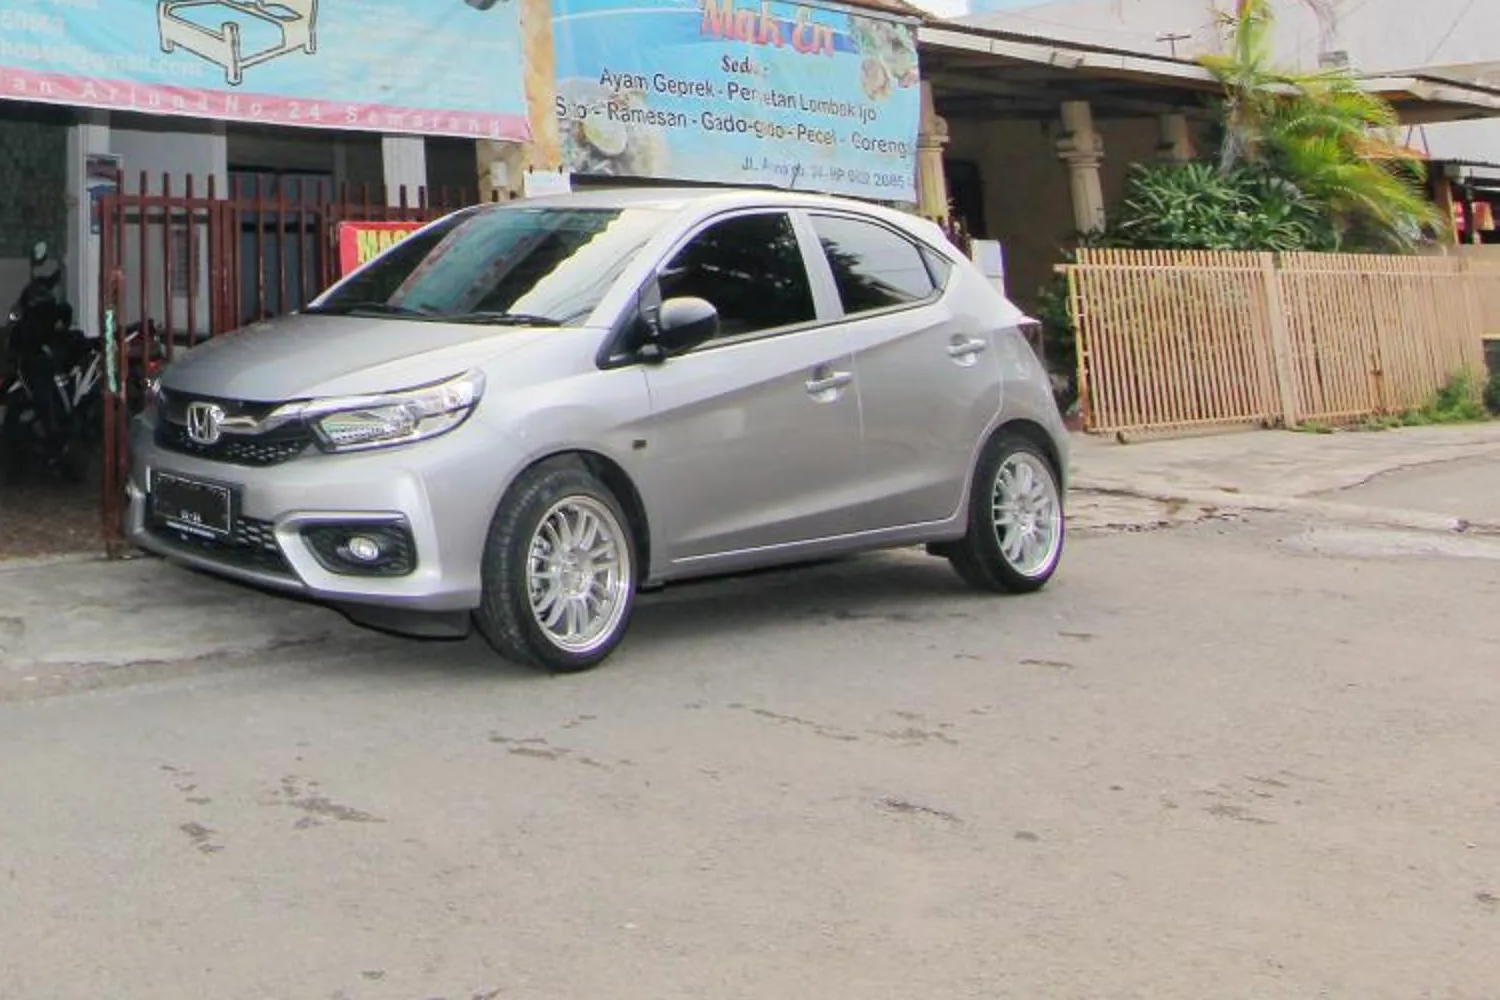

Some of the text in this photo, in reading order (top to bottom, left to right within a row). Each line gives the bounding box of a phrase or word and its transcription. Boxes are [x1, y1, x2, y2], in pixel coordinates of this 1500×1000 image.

[81, 81, 209, 110] Arjuna
[600, 66, 650, 92] Ayam
[653, 72, 715, 98] Geprek
[727, 81, 797, 109] Penetan
[607, 101, 688, 129] Ramesan
